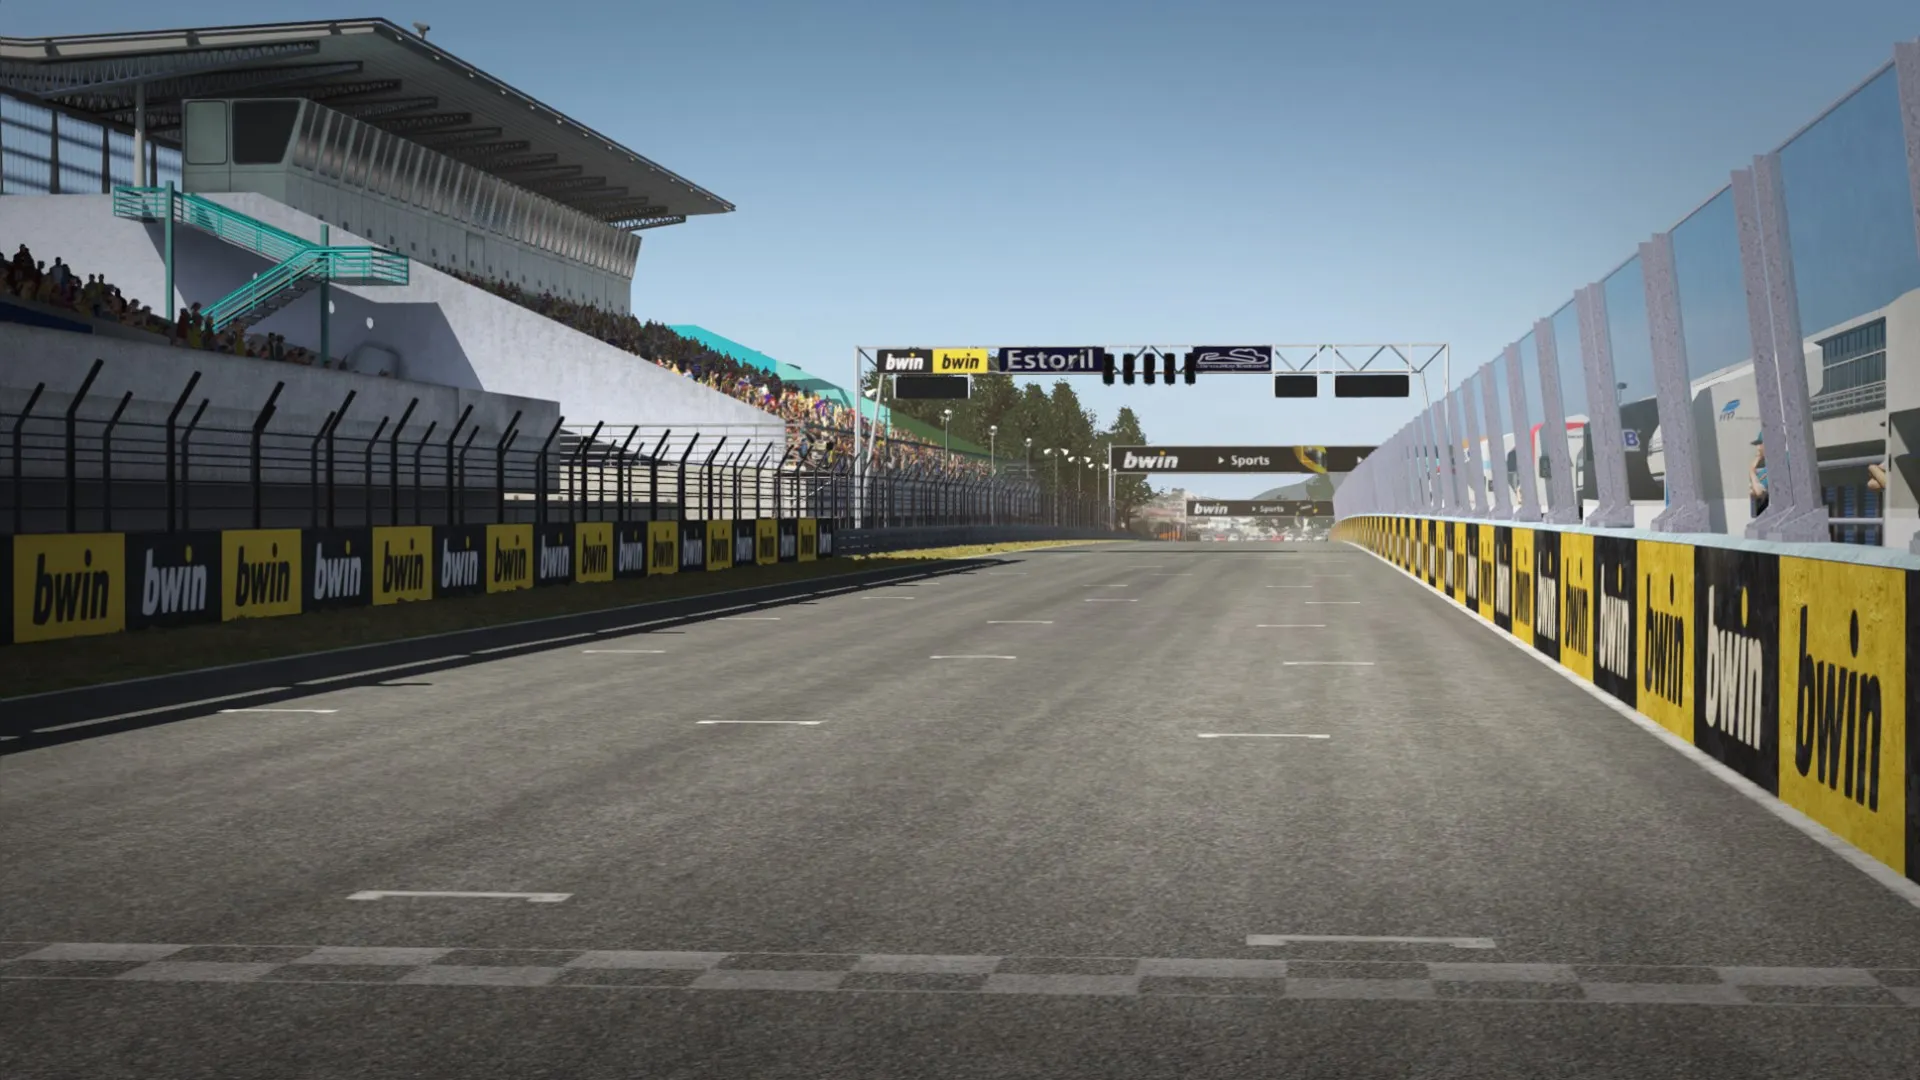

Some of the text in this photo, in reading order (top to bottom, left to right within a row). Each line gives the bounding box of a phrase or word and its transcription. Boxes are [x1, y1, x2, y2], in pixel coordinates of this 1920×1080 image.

[886, 353, 924, 370] bwin
[942, 352, 979, 370] bwin
[1007, 349, 1093, 369] Estoril
[1123, 451, 1270, 469] bwin Sports
[1194, 502, 1228, 515] bwin
[314, 540, 361, 600] bwin
[382, 538, 424, 593] bwin
[441, 536, 478, 588] bwin
[494, 535, 526, 582] bwin
[540, 533, 569, 579] bwin
[582, 531, 608, 575] bwin
[618, 530, 643, 572] bwin
[653, 530, 674, 568] bwin
[683, 529, 702, 566] bwin
[710, 528, 729, 563] bwin
[33, 549, 109, 625] bwin
[142, 545, 207, 616] bwin
[235, 543, 290, 607] bwin
[1537, 552, 1556, 641] bwin
[1565, 557, 1588, 657] bwin
[1599, 563, 1629, 680] bwin
[1645, 573, 1684, 708] bwin
[1705, 584, 1763, 750] bwin
[1795, 604, 1882, 813] bwin
